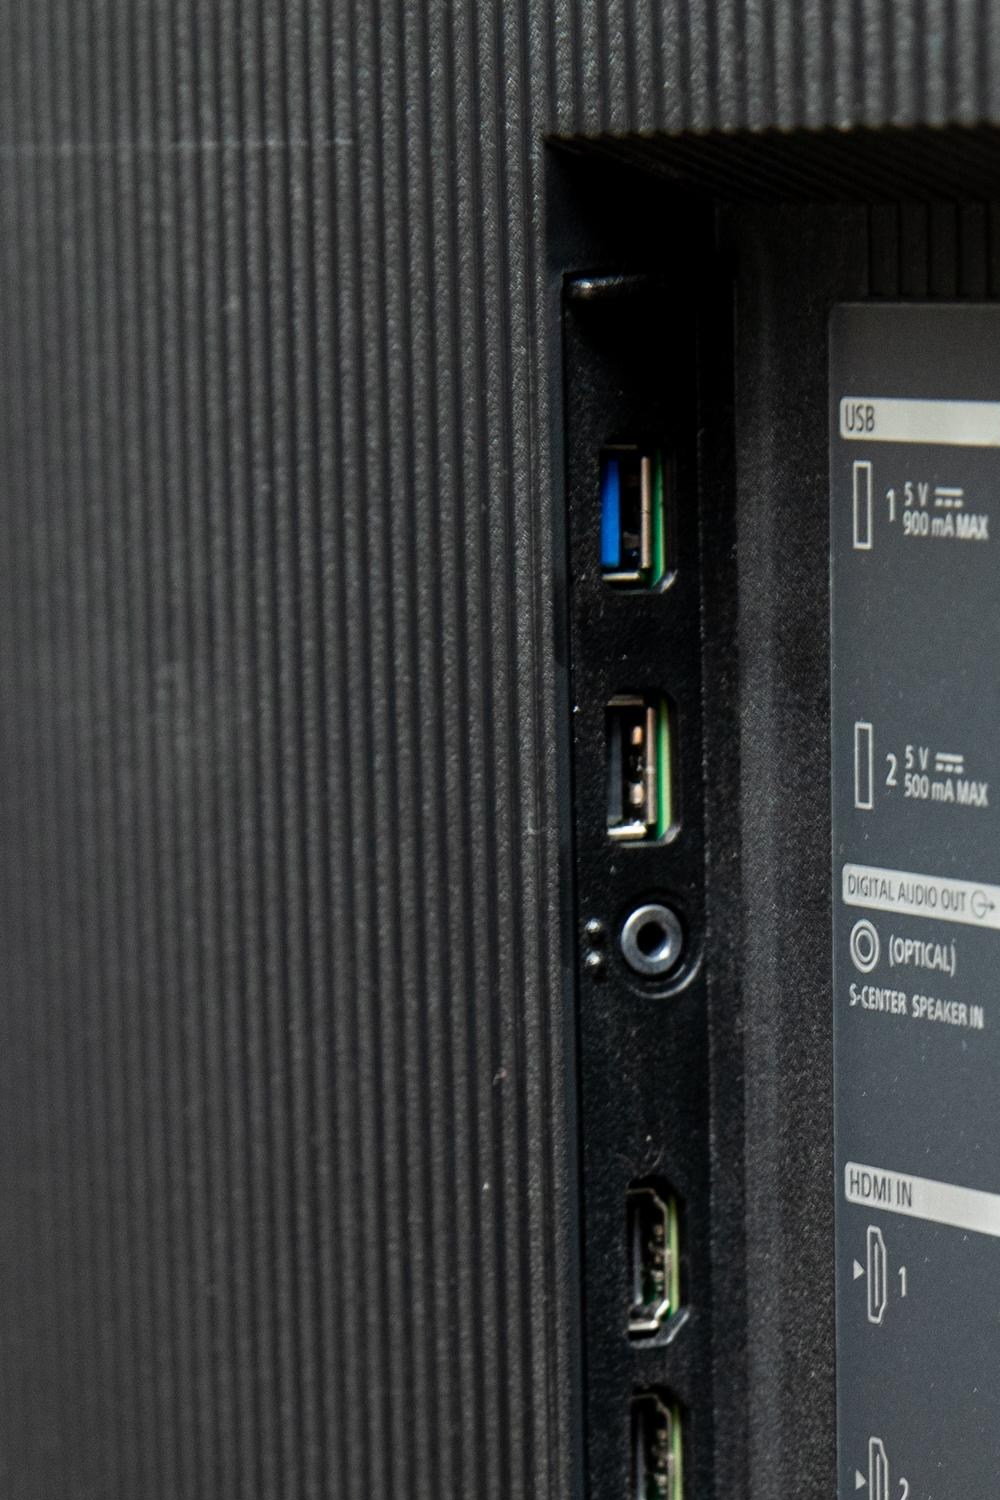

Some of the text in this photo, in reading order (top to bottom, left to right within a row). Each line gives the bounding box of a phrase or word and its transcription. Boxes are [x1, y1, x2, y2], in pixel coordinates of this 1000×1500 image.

[846, 403, 875, 432] USB
[886, 489, 896, 522] 1
[904, 481, 928, 507] 5 V
[904, 510, 989, 540] 900 mA MAX
[886, 753, 897, 786] 2
[905, 744, 929, 771] 5 V
[904, 772, 989, 807] 500 mA MAX
[848, 875, 966, 912] DIGITAL AUDIO OUT
[889, 934, 956, 978] (OPTICAL)
[849, 983, 984, 1029] S-CENTER SPEAKER IN
[850, 1169, 912, 1208] HDMI IN
[898, 1266, 906, 1297] 1
